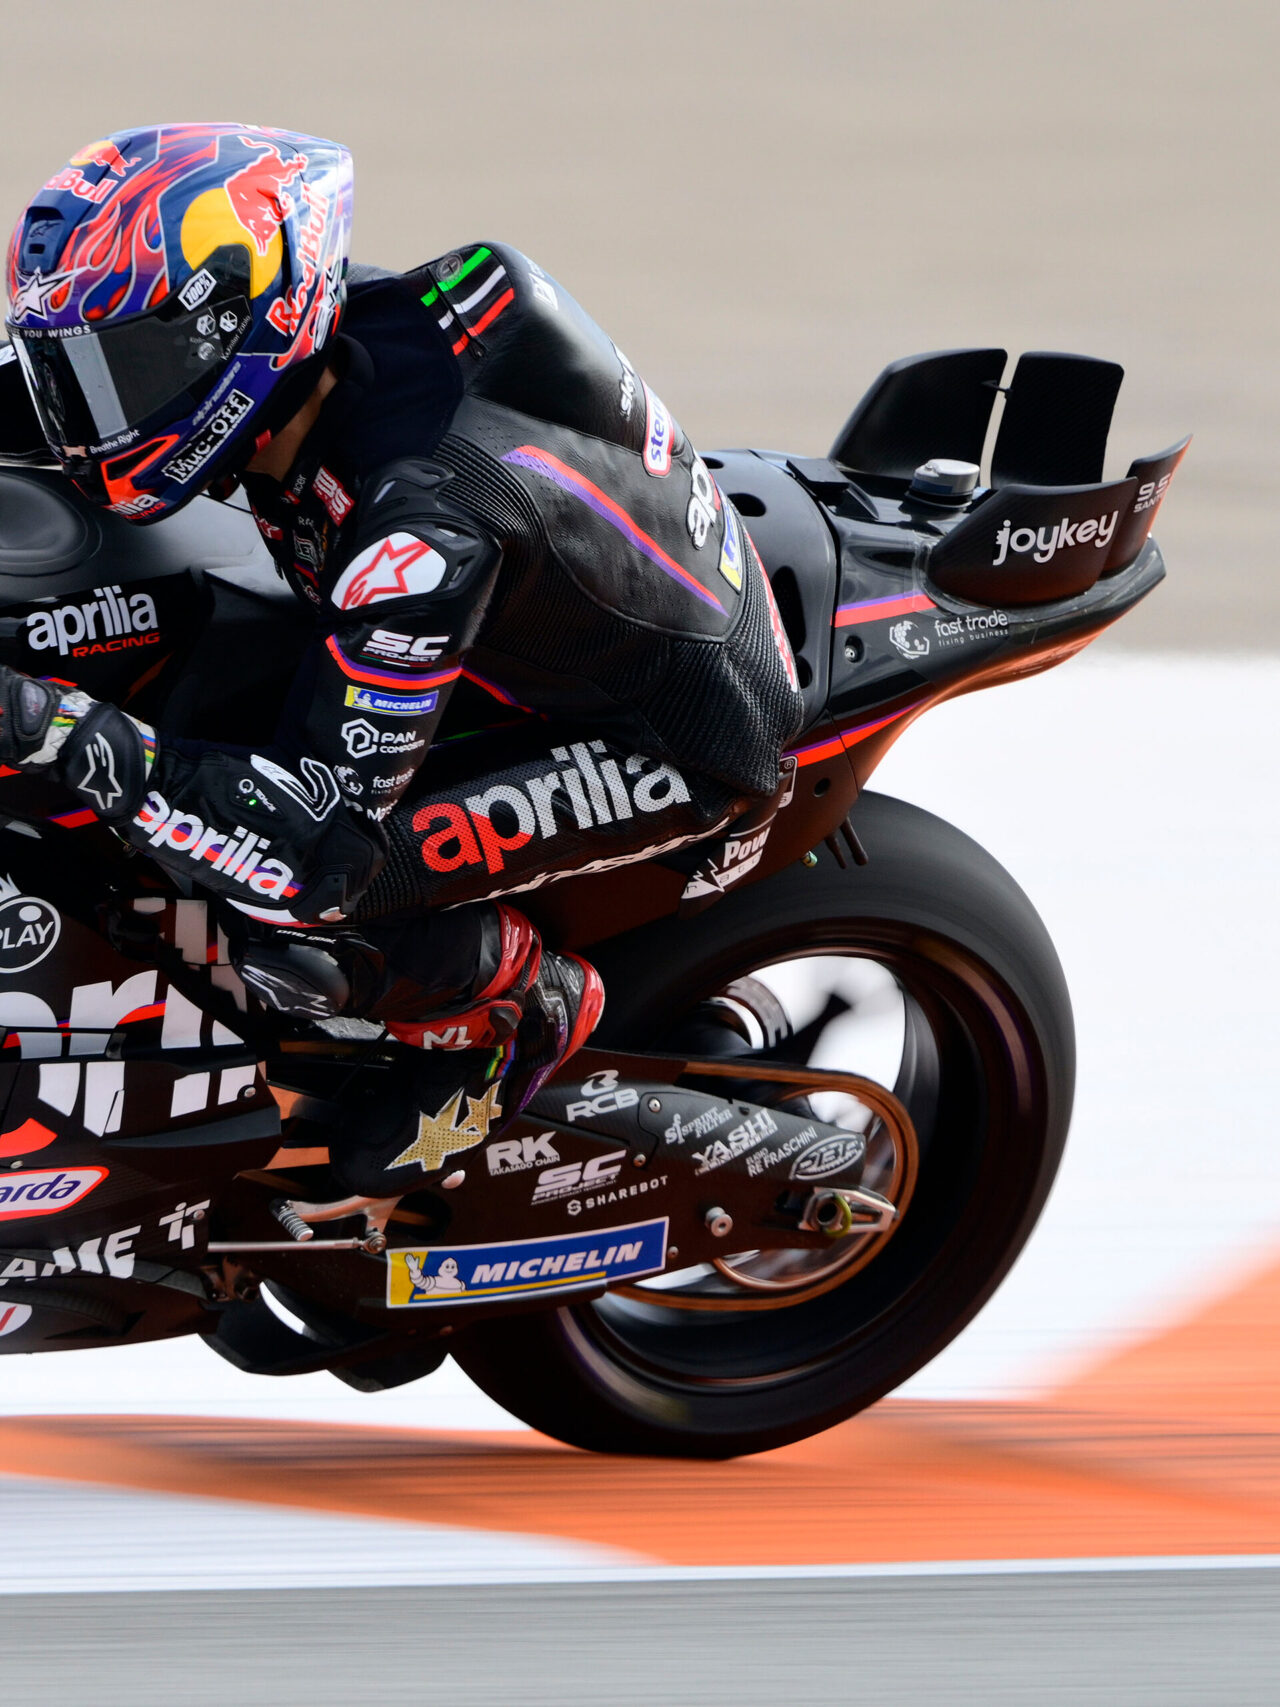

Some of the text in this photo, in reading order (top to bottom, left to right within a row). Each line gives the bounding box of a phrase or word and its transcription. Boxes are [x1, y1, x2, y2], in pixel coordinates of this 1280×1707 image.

[24, 329, 43, 338] YOU
[47, 324, 91, 338] WINGS
[118, 428, 140, 446] Right
[171, 391, 247, 478] Muc-Off
[992, 510, 1119, 566] joykey
[27, 585, 159, 656] aprilia
[934, 609, 1009, 637] fast trade
[73, 632, 160, 658] RACING
[365, 629, 449, 656] SC
[939, 629, 1009, 648] fixing business
[362, 647, 439, 662] PROJECT
[374, 697, 432, 710] MICHELIN
[381, 731, 417, 744] PAN
[373, 775, 396, 789] fast
[411, 739, 689, 876] aprilia
[132, 789, 298, 898] aprilia
[566, 1088, 640, 1122] RCB
[682, 1106, 719, 1136] SPRINT
[486, 1131, 560, 1174] RK
[489, 1153, 560, 1176] TAKASAGO CHAIN
[535, 1149, 628, 1193] SC
[585, 1175, 669, 1209] SHAREBOT
[470, 1241, 645, 1285] MICHELIN
